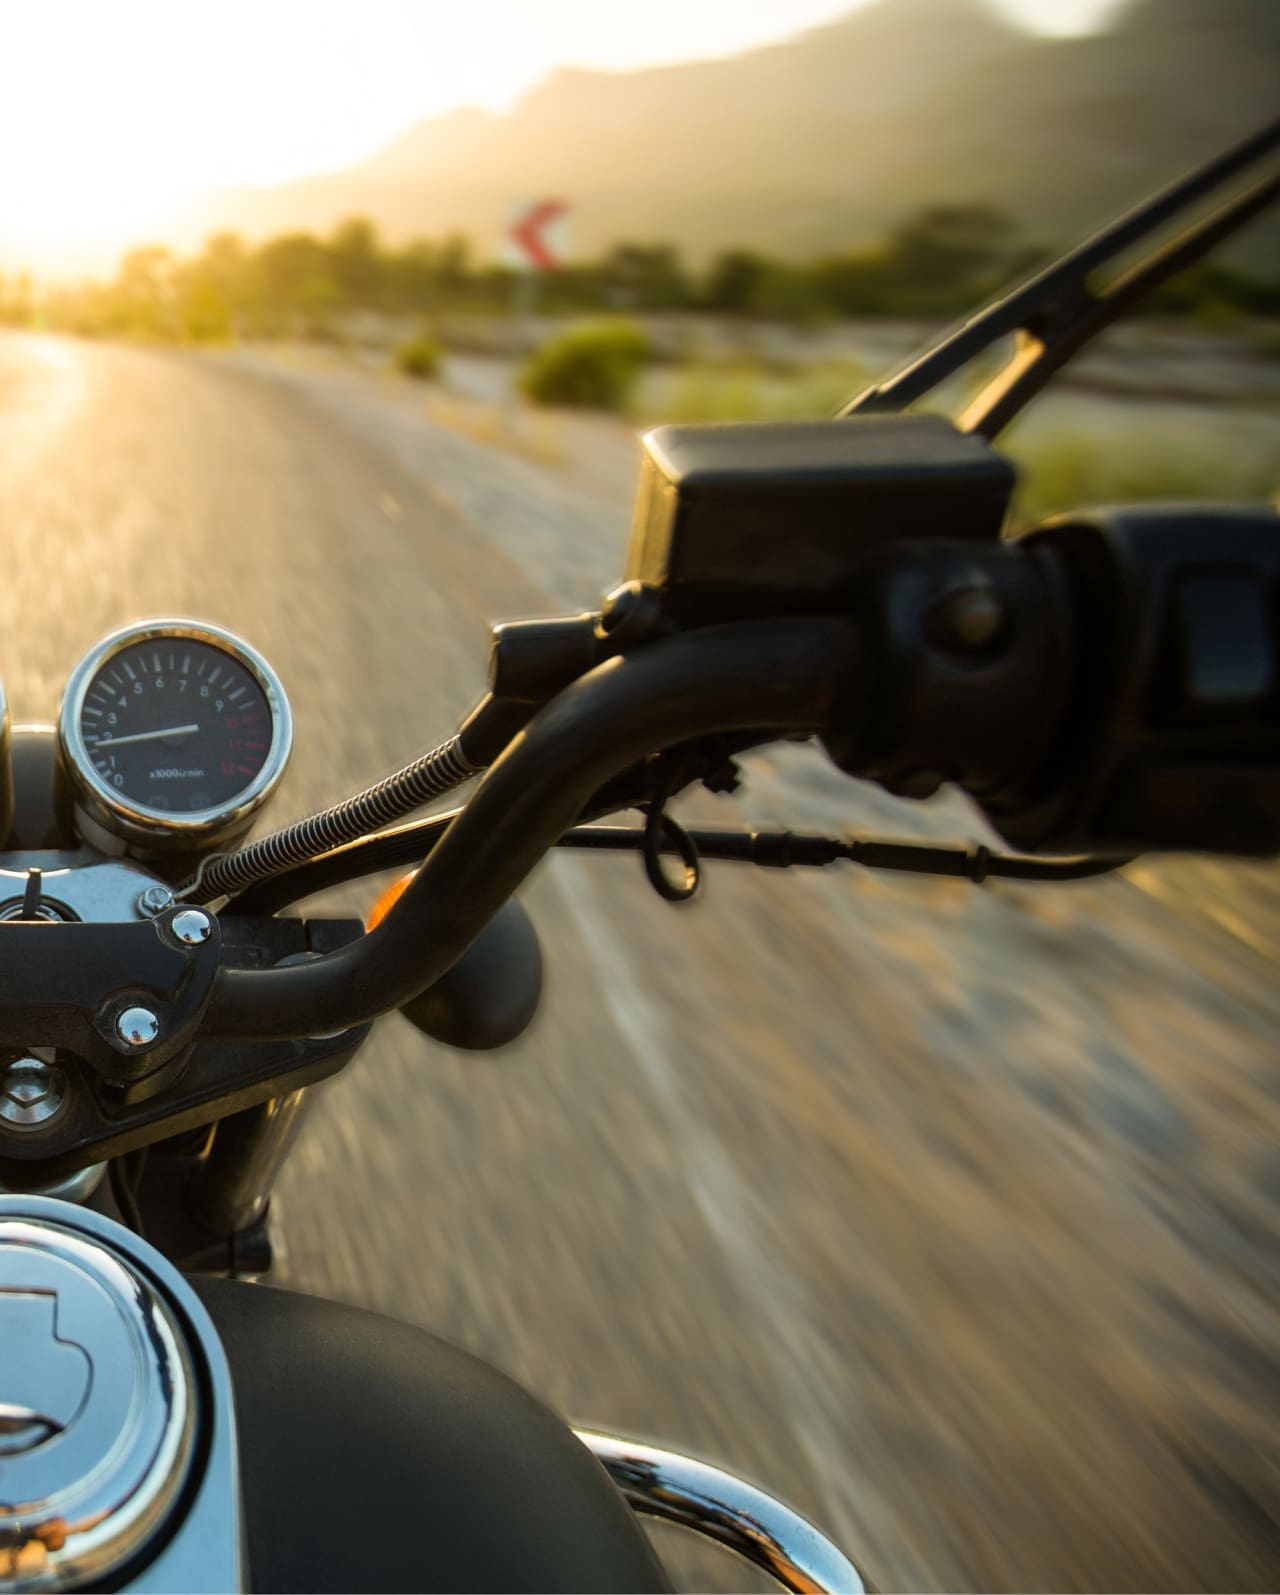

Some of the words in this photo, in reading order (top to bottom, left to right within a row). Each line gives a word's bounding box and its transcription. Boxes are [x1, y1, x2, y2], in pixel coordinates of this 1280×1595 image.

[133, 682, 143, 694] 5
[156, 676, 164, 688] 6
[179, 680, 187, 692] 7
[200, 684, 209, 697] 8
[118, 696, 127, 708] 4
[215, 700, 224, 712] 9
[108, 712, 117, 725] 3
[225, 718, 238, 729] 10
[109, 755, 116, 768] 1
[114, 773, 124, 787] 0
